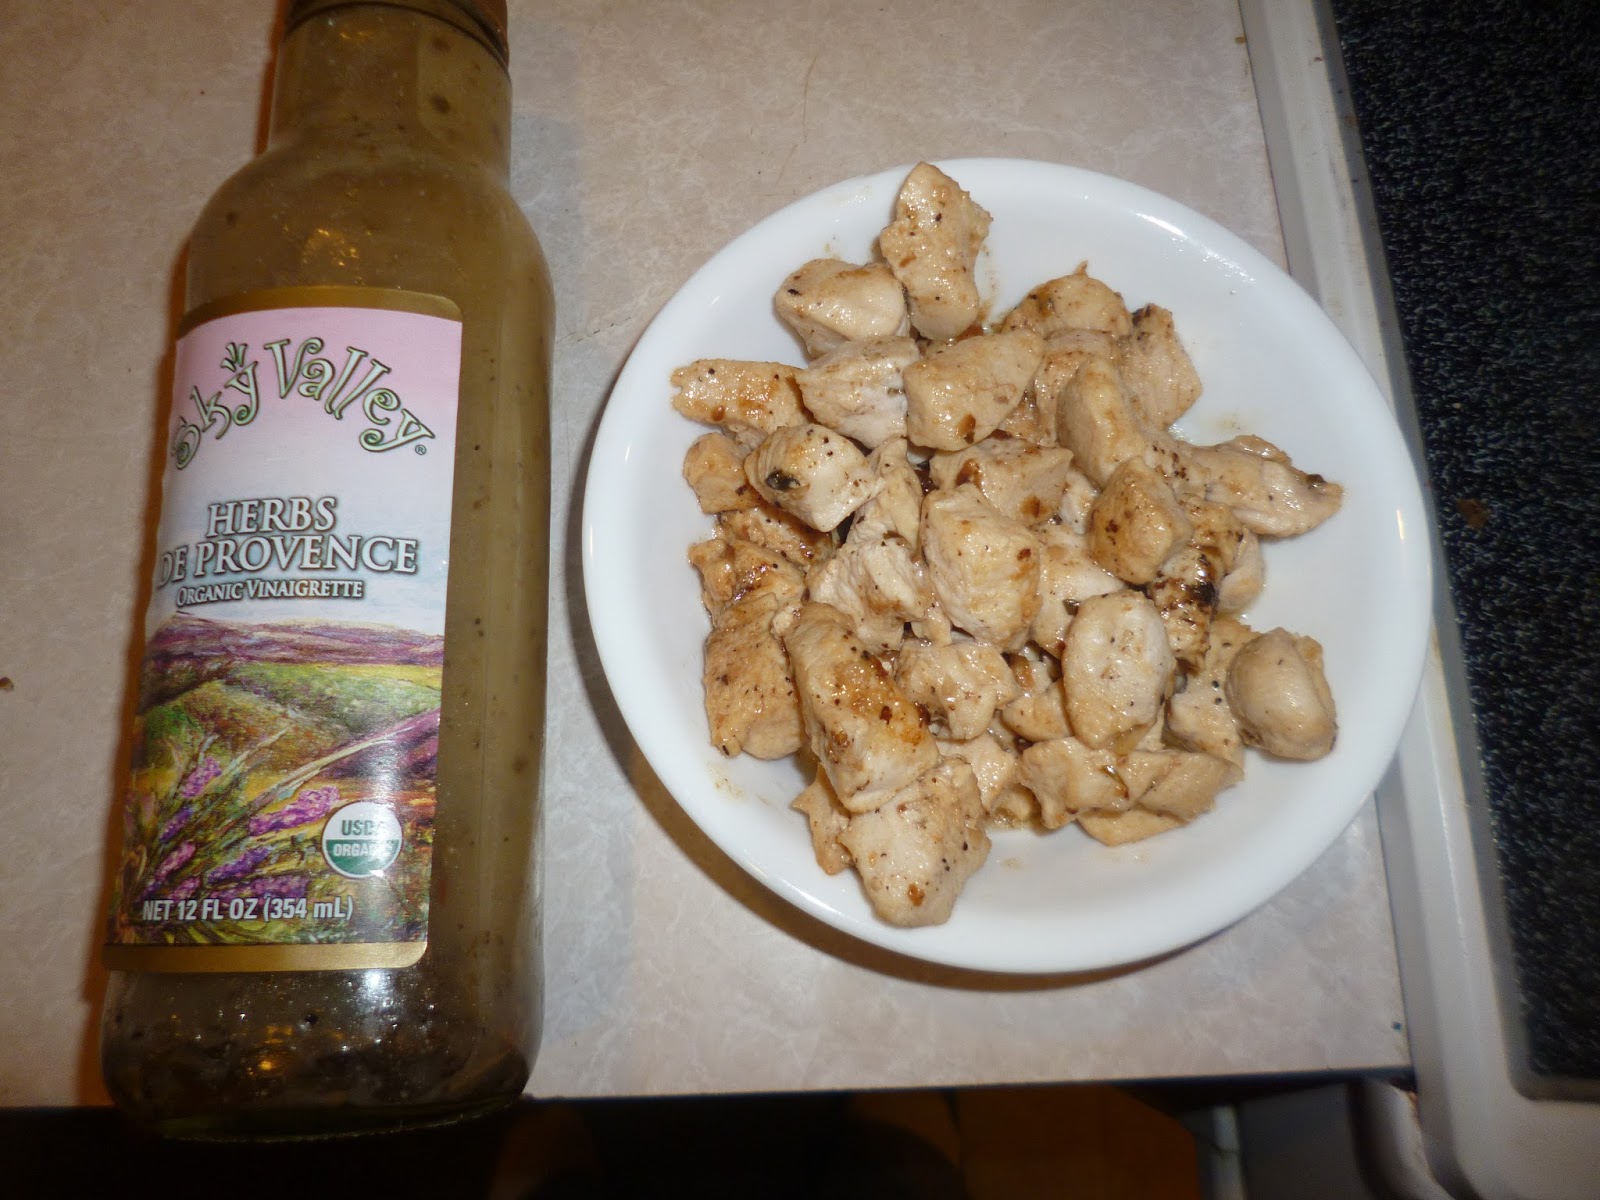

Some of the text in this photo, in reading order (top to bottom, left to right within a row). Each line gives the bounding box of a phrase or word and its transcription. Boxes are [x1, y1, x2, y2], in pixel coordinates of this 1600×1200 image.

[264, 337, 436, 453] Valley
[206, 496, 337, 538] HERBS
[158, 534, 419, 589] DE PROVENCE
[176, 578, 364, 607] ORGANIC VINAIGRETTE
[141, 895, 354, 922] NET 12 FL OZ (354 mL)
